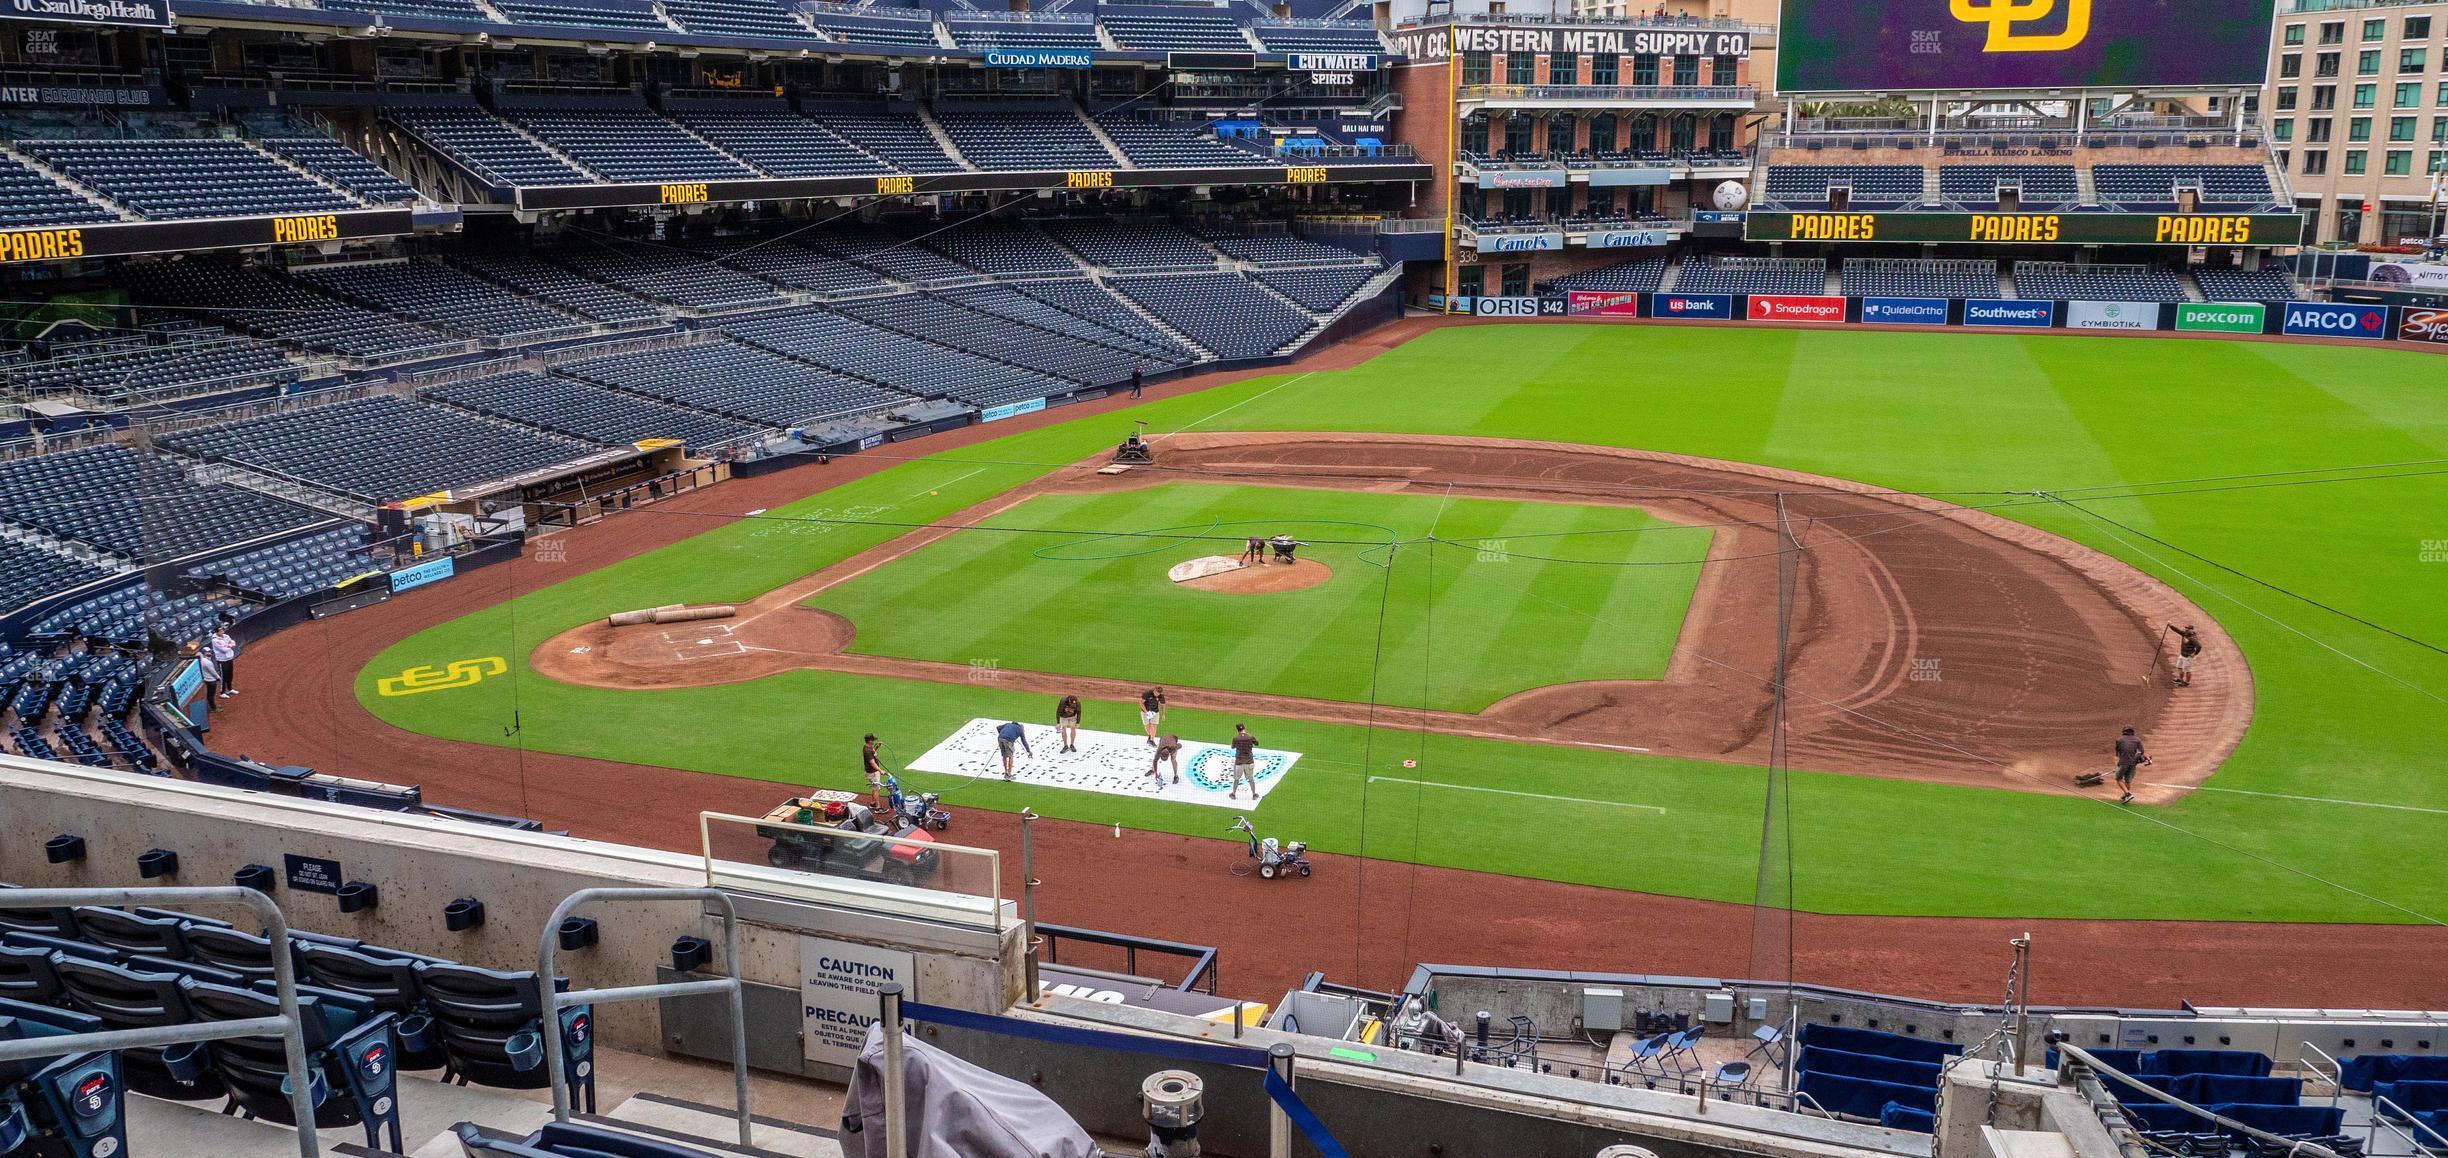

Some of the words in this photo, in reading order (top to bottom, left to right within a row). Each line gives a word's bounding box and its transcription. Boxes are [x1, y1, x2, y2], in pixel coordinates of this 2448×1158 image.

[38, 0, 69, 14] San
[70, 0, 110, 20] Diego
[111, 0, 156, 20] Health
[1454, 28, 1553, 52] WESTERN
[1563, 31, 1629, 54] METAL
[1634, 32, 1709, 55] SUPPLY
[1716, 34, 1748, 56] CO.
[1298, 54, 1368, 69] CUTWATER
[1311, 73, 1354, 85] SPIRITS
[42, 88, 114, 105] CORONADO
[116, 89, 150, 105] CLUB
[1341, 124, 1357, 133] BALI
[1358, 124, 1369, 133] HAI
[1370, 125, 1384, 133] RUM
[1943, 149, 1989, 157] ESTRELLA
[1991, 149, 2029, 157] JALISCO
[2031, 149, 2073, 157] LANDING
[1067, 171, 1113, 188] PADRES
[1286, 168, 1327, 183] PADRES
[877, 177, 913, 194] PADRES
[660, 183, 708, 204] PADRES
[273, 215, 338, 242] PADRES
[1790, 214, 1875, 240] PADRES
[1970, 215, 2059, 241] PADRES
[2155, 216, 2250, 243] PADRES
[0, 229, 83, 261] PADRES
[1493, 235, 1548, 252] Canel's
[1602, 231, 1654, 248] Canel's
[2399, 237, 2424, 246] petco
[1459, 250, 1479, 263] 336
[1479, 298, 1536, 315] ORIS
[1542, 300, 1564, 314] 342
[1670, 301, 1684, 309] us
[1685, 299, 1714, 311] bank
[1775, 303, 1839, 317] Snapdragon
[1881, 305, 1943, 316] QuidelOrtho
[1970, 306, 2037, 319] Southwest
[2081, 320, 2142, 328] CYMBIOTIKA
[2287, 310, 2358, 330] ARCO
[393, 571, 422, 590] petco
[303, 863, 322, 872] PLEASE
[819, 957, 894, 980] CAUTION
[817, 971, 826, 979] BE
[828, 972, 853, 983] AWARE
[809, 978, 839, 989] LEAVING
[841, 984, 854, 992] THE
[855, 987, 875, 995] FIELD
[821, 1023, 838, 1032] ESTE
[814, 1029, 844, 1041] OBJETOS
[845, 1034, 859, 1043] QUE
[379, 1101, 386, 1110] 2
[101, 1142, 110, 1153] 3
